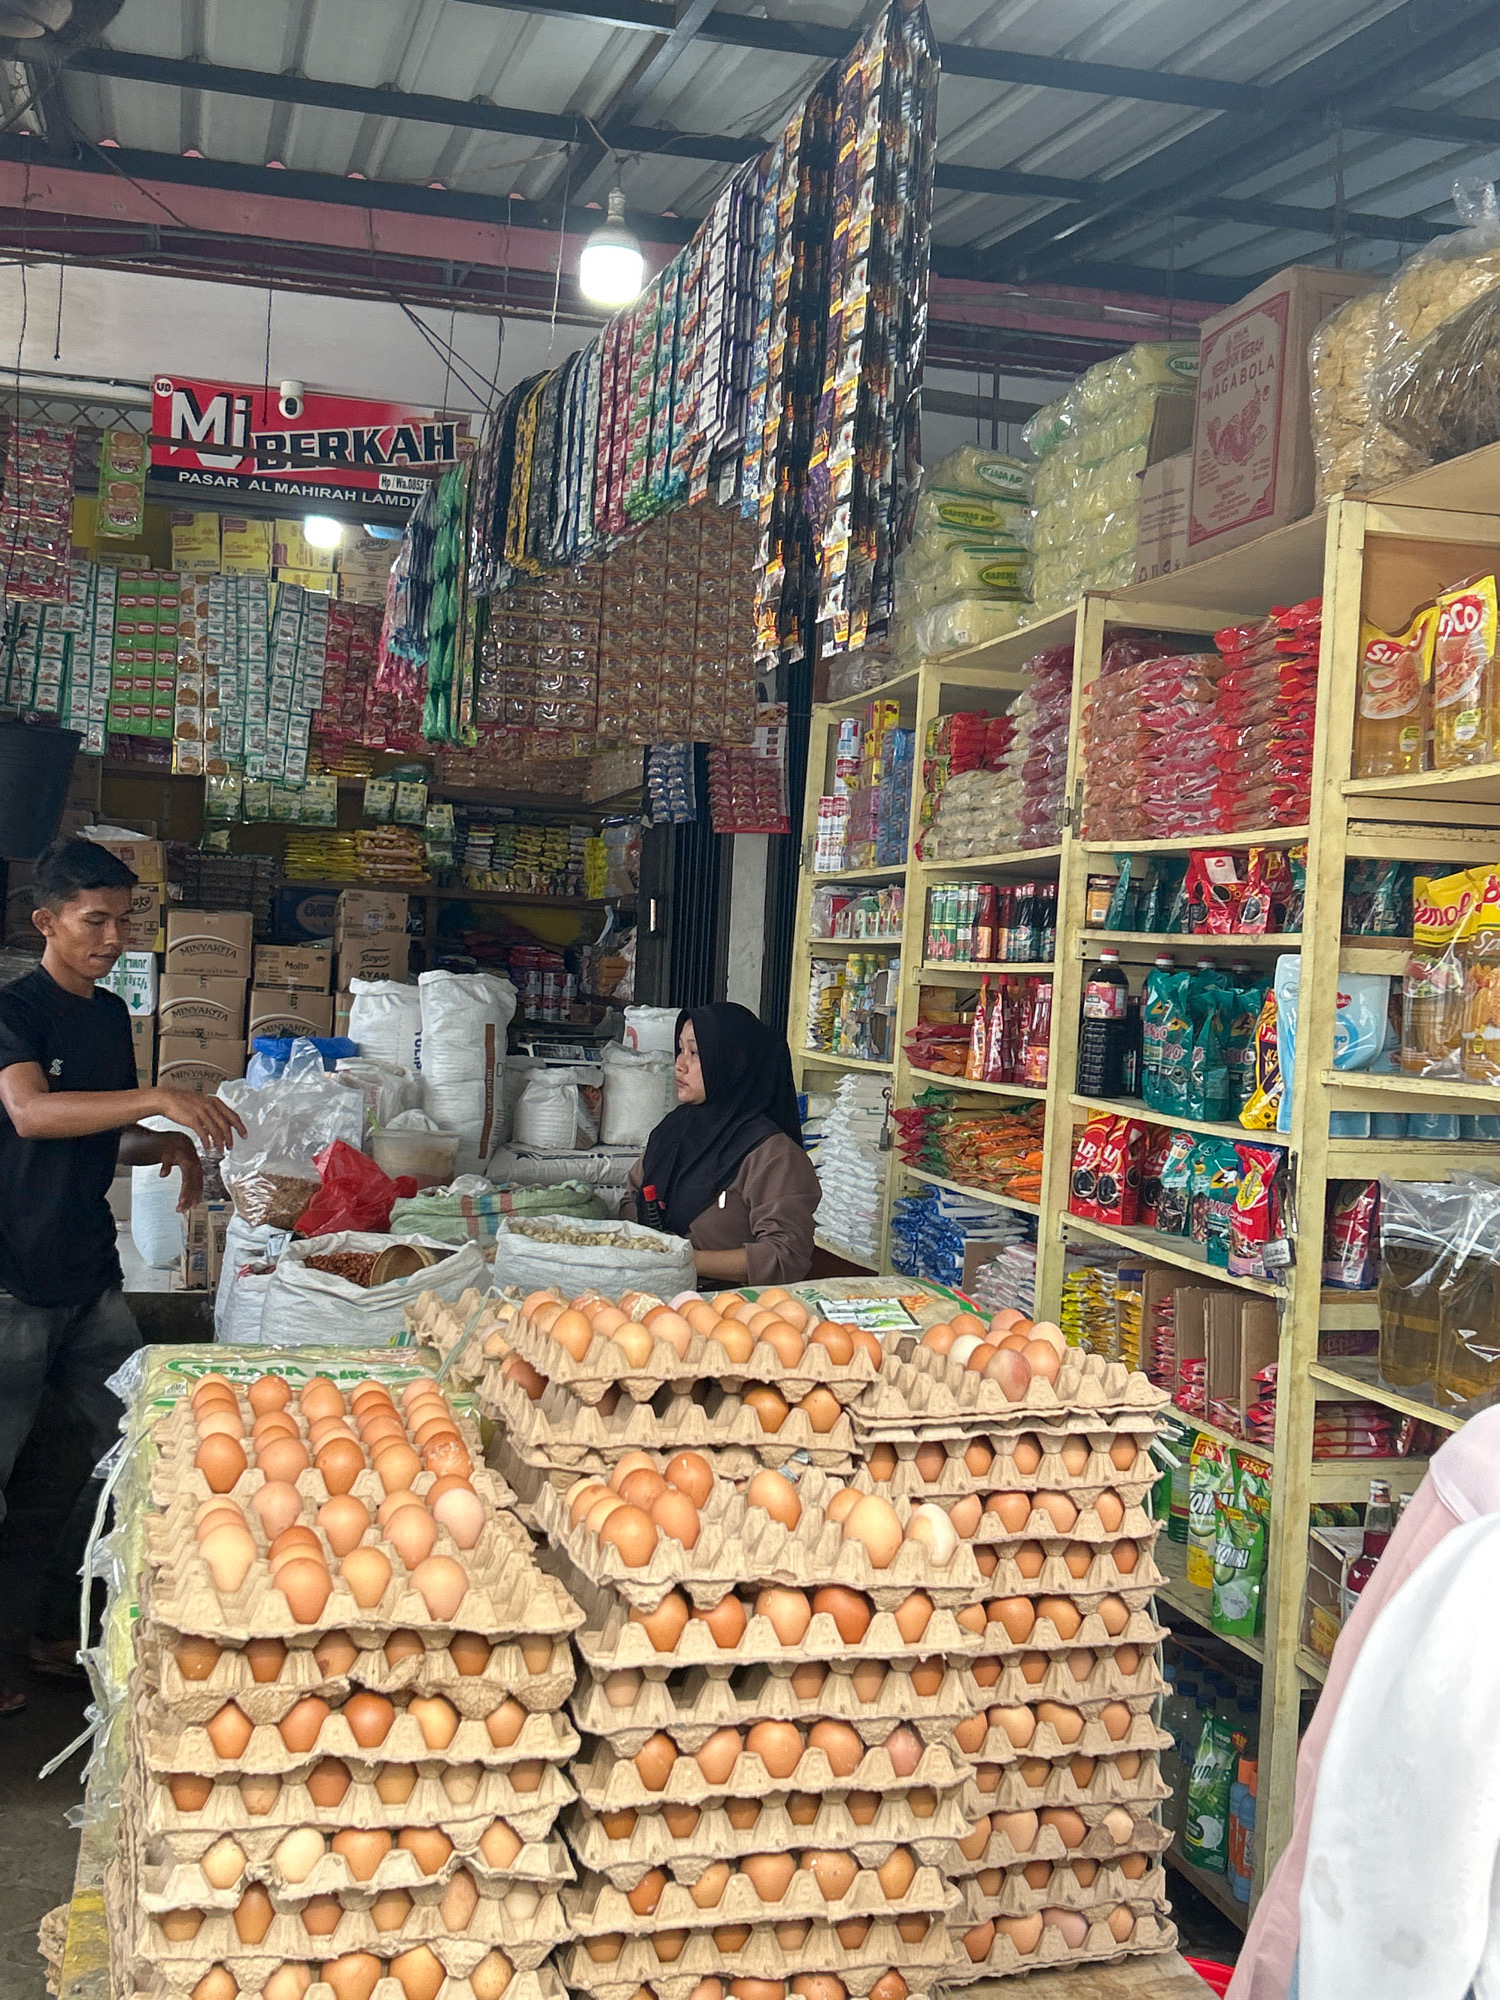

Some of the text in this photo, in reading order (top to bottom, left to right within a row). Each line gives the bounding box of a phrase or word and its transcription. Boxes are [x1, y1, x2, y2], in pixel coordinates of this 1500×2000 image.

[251, 421, 459, 473] BERKAH
[178, 471, 239, 489] PASAR
[180, 943, 237, 959] MINYAKITA
[284, 960, 309, 971] Molto
[358, 970, 390, 981] AYAM
[171, 1006, 228, 1022] MINYAKITA
